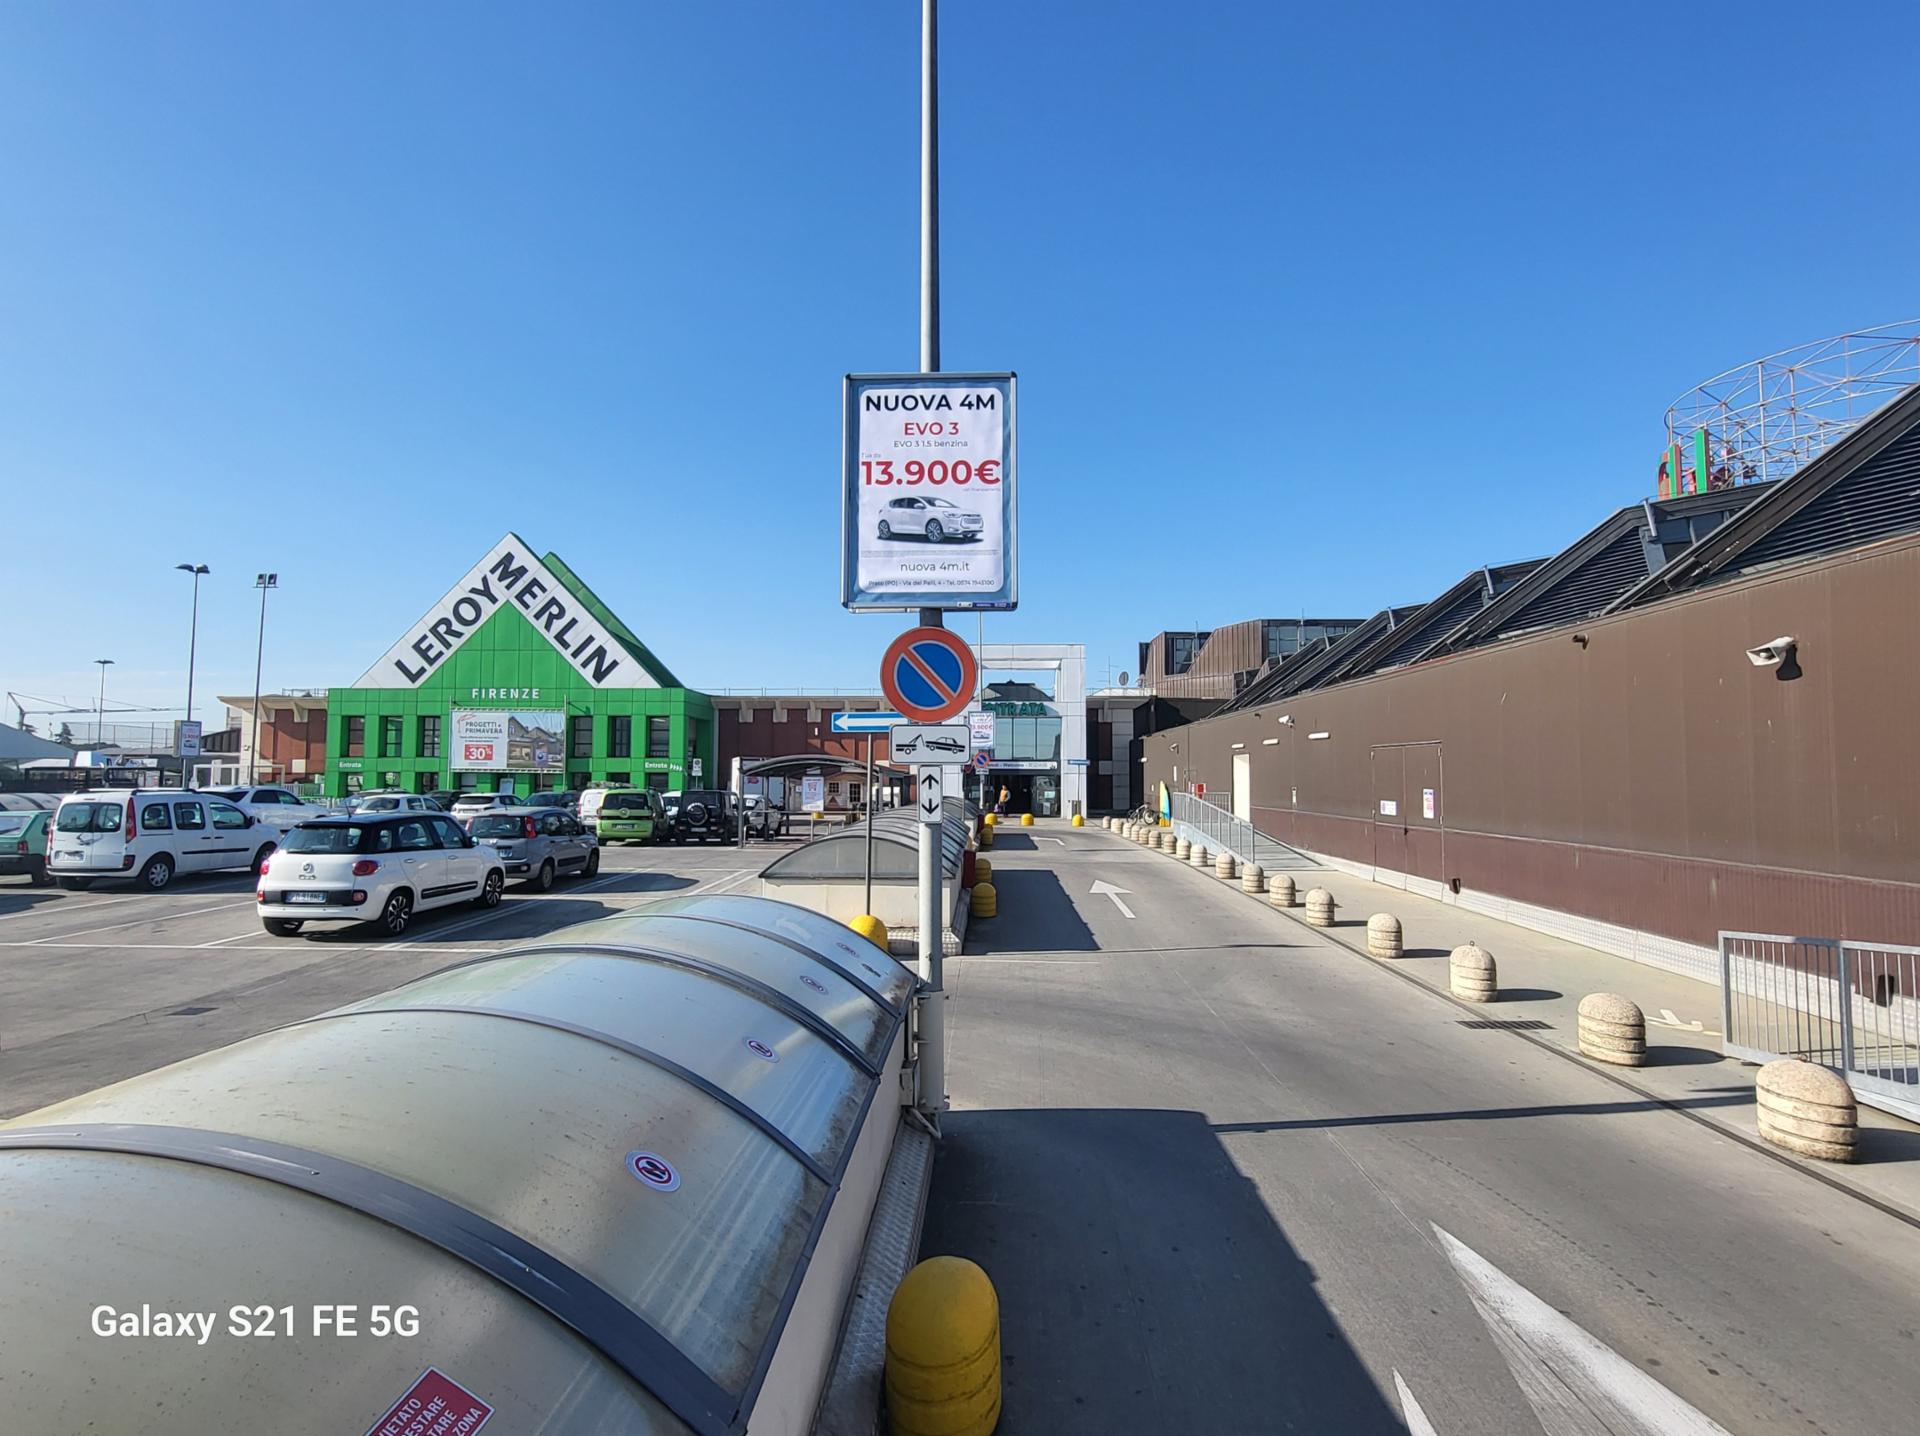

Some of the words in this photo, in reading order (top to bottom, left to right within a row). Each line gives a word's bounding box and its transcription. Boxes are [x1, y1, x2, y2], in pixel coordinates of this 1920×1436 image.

[866, 394, 952, 411] NUOVA
[959, 394, 995, 410] 4M
[904, 422, 943, 435] EVO
[949, 422, 959, 435] 3
[893, 440, 912, 448] EVO
[861, 460, 1000, 485] 13.900€
[900, 563, 936, 572] nuova
[940, 561, 970, 572] 4m.it
[394, 574, 499, 684] LEROY
[489, 551, 619, 684] MERLIN
[471, 687, 541, 700] FIRENZE
